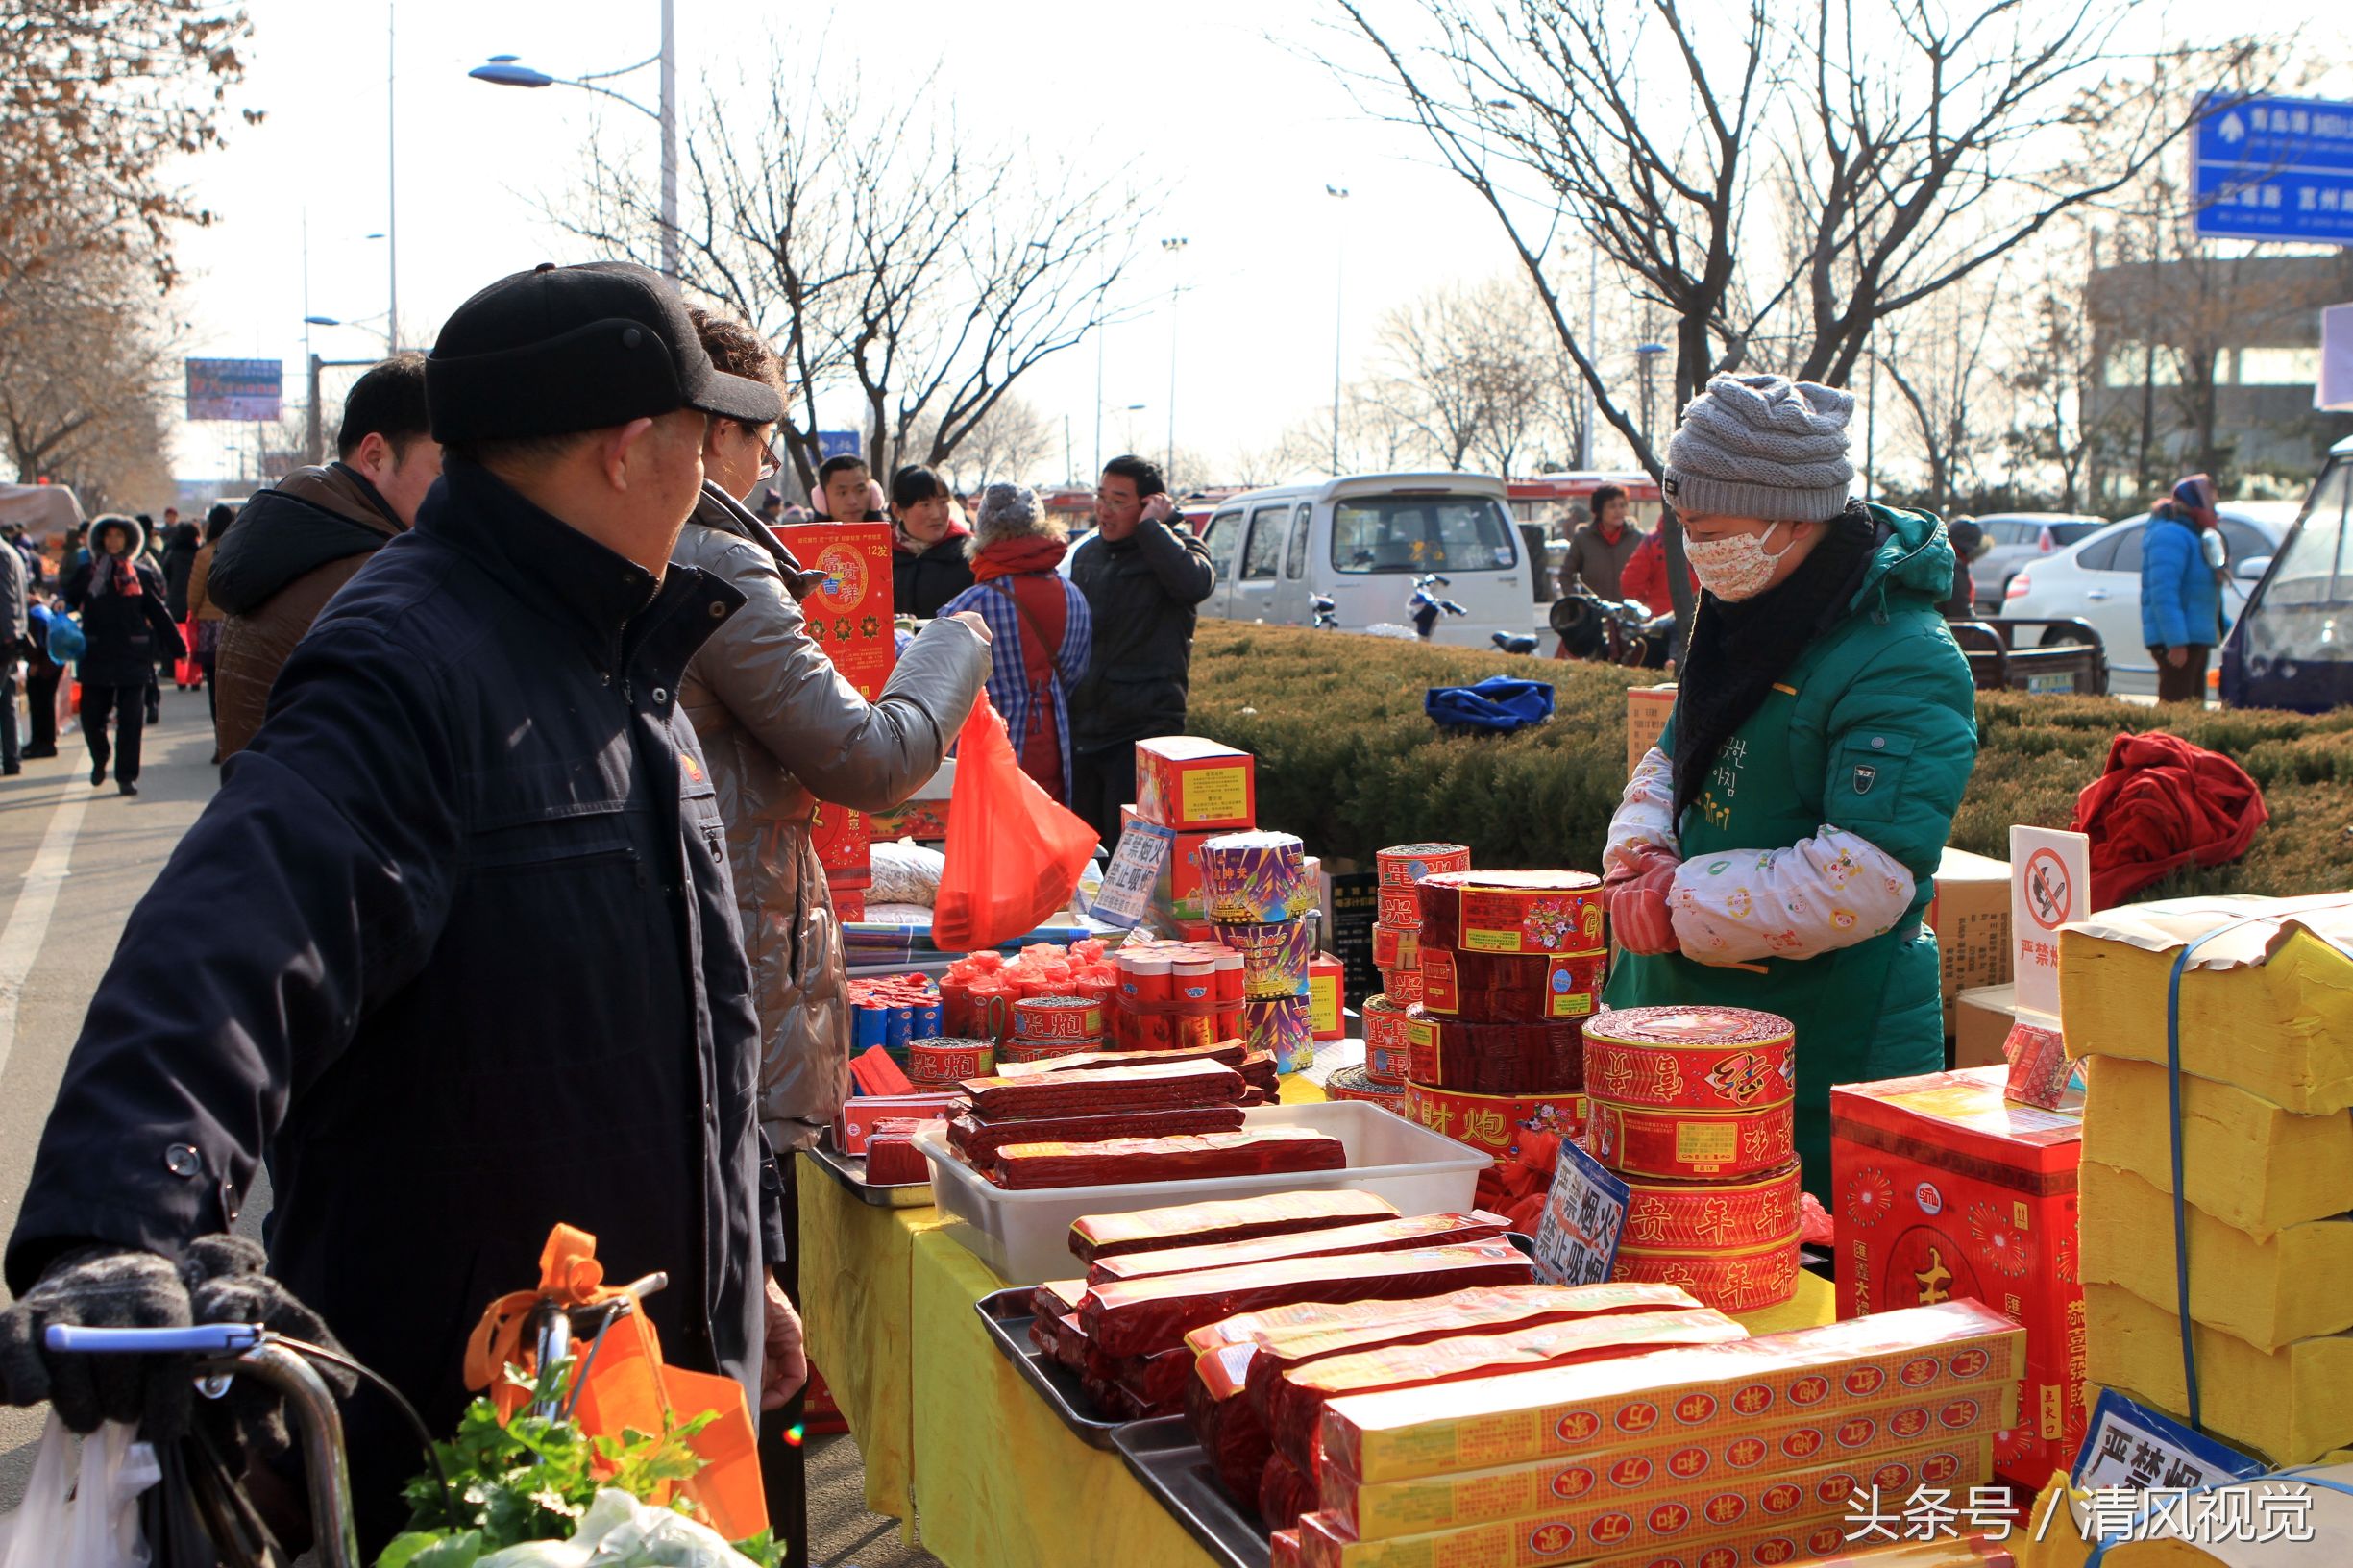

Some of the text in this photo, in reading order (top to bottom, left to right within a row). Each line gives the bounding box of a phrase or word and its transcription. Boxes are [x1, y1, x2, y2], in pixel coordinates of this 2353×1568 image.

[868, 545, 888, 557] 12发
[823, 554, 860, 580] 富贵
[822, 577, 859, 604] 吉祥
[1713, 767, 1736, 797] 아침
[1118, 832, 1164, 865] 严禁烟火
[1106, 861, 1155, 894] 禁止吸烟
[1021, 1013, 1082, 1039] 光炮
[914, 1053, 974, 1080] 光炮
[1551, 1164, 1617, 1249] 严禁烟火
[1536, 1213, 1605, 1285] 禁止吸烟
[2044, 1390, 2056, 1434] 点火口
